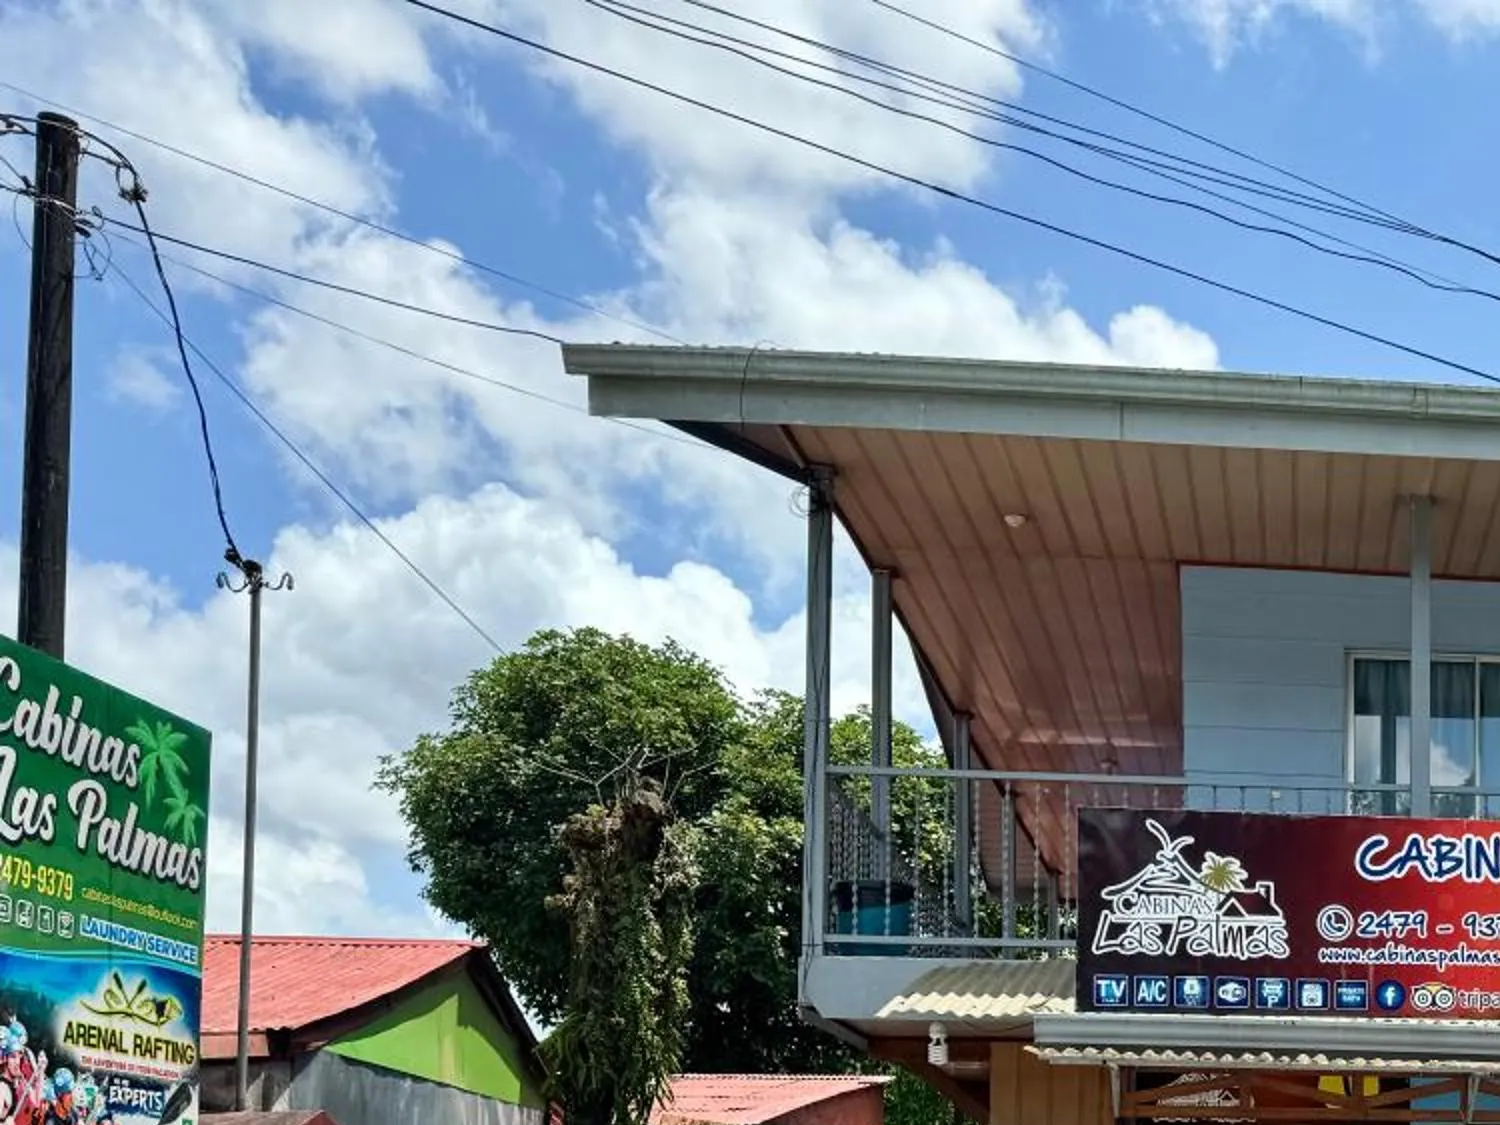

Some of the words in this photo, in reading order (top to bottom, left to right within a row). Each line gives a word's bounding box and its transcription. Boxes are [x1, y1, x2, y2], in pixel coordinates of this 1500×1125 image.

[0, 656, 141, 788] Cabinas
[0, 746, 57, 841] Las
[67, 779, 201, 889] Palmas
[0, 853, 73, 901] 479-9379
[1114, 892, 1217, 916] CABINAS
[1356, 913, 1427, 938] 2479
[82, 917, 145, 949] LAUNDRY
[146, 935, 198, 963] SERVICE
[1092, 911, 1163, 956] Las
[1166, 911, 1291, 960] Palmas
[1097, 979, 1127, 998] TV
[1136, 979, 1167, 1003] A/C
[63, 1020, 128, 1053] ARENAL
[133, 1033, 195, 1065] RAFTING
[109, 1085, 163, 1111] EXPERTS
